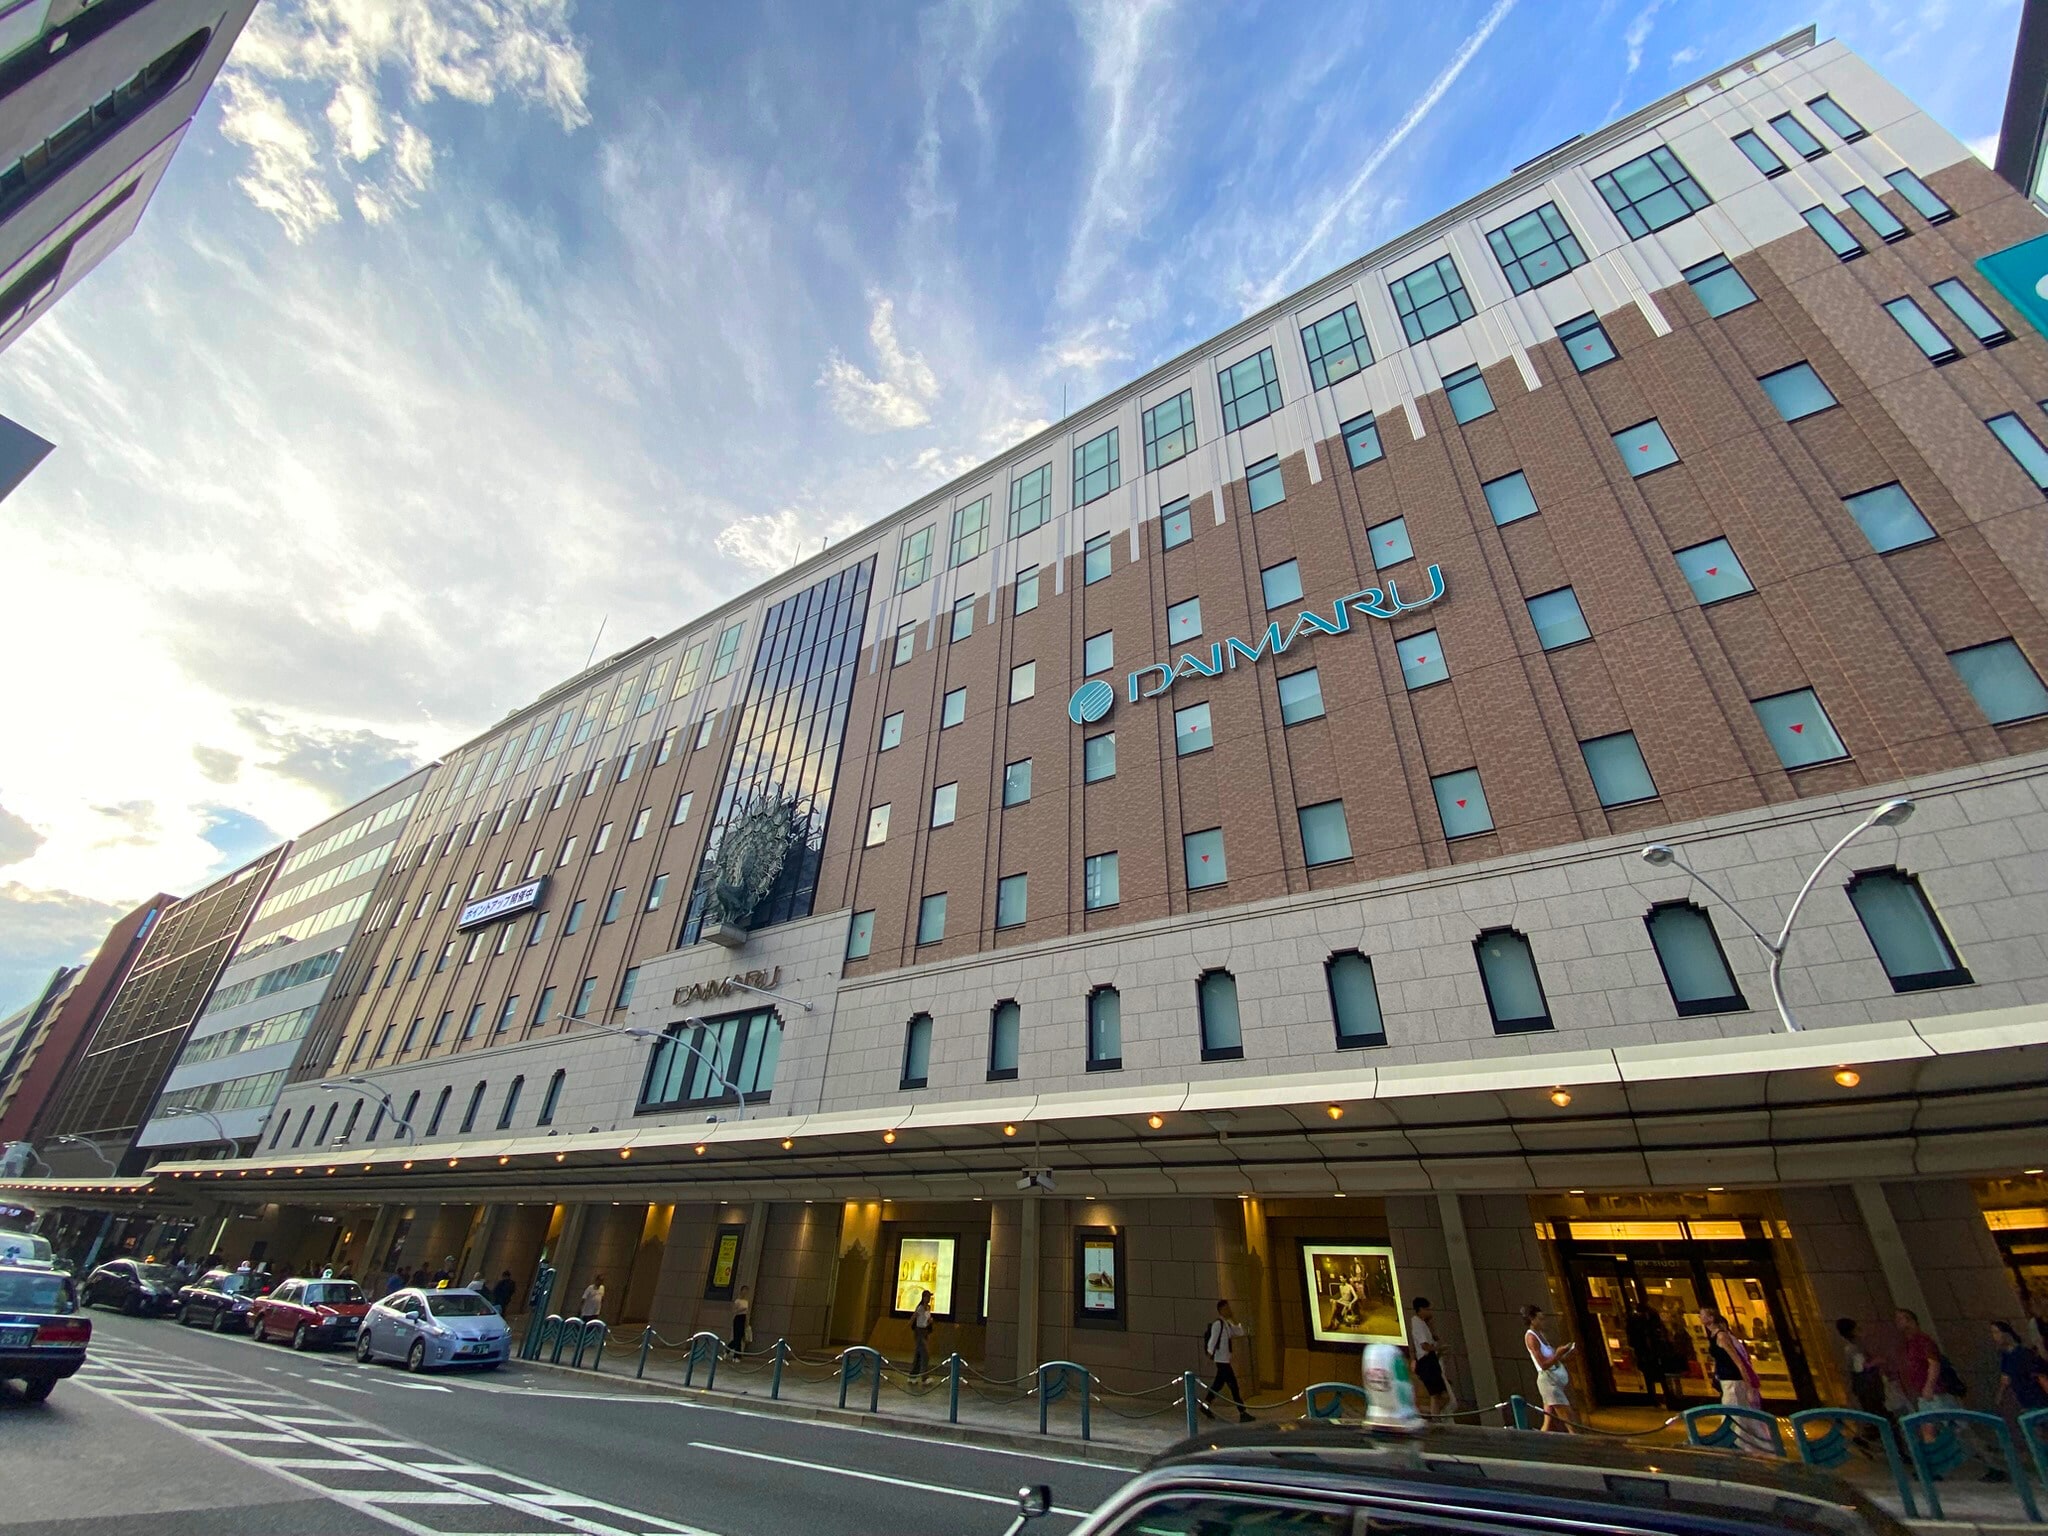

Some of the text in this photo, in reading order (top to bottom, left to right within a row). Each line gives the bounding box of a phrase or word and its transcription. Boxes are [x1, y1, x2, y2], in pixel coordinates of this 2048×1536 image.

[1127, 563, 1446, 703] DAIMARU
[464, 888, 534, 920] ポイントアップ開催中
[672, 965, 782, 1008] DAIMARU
